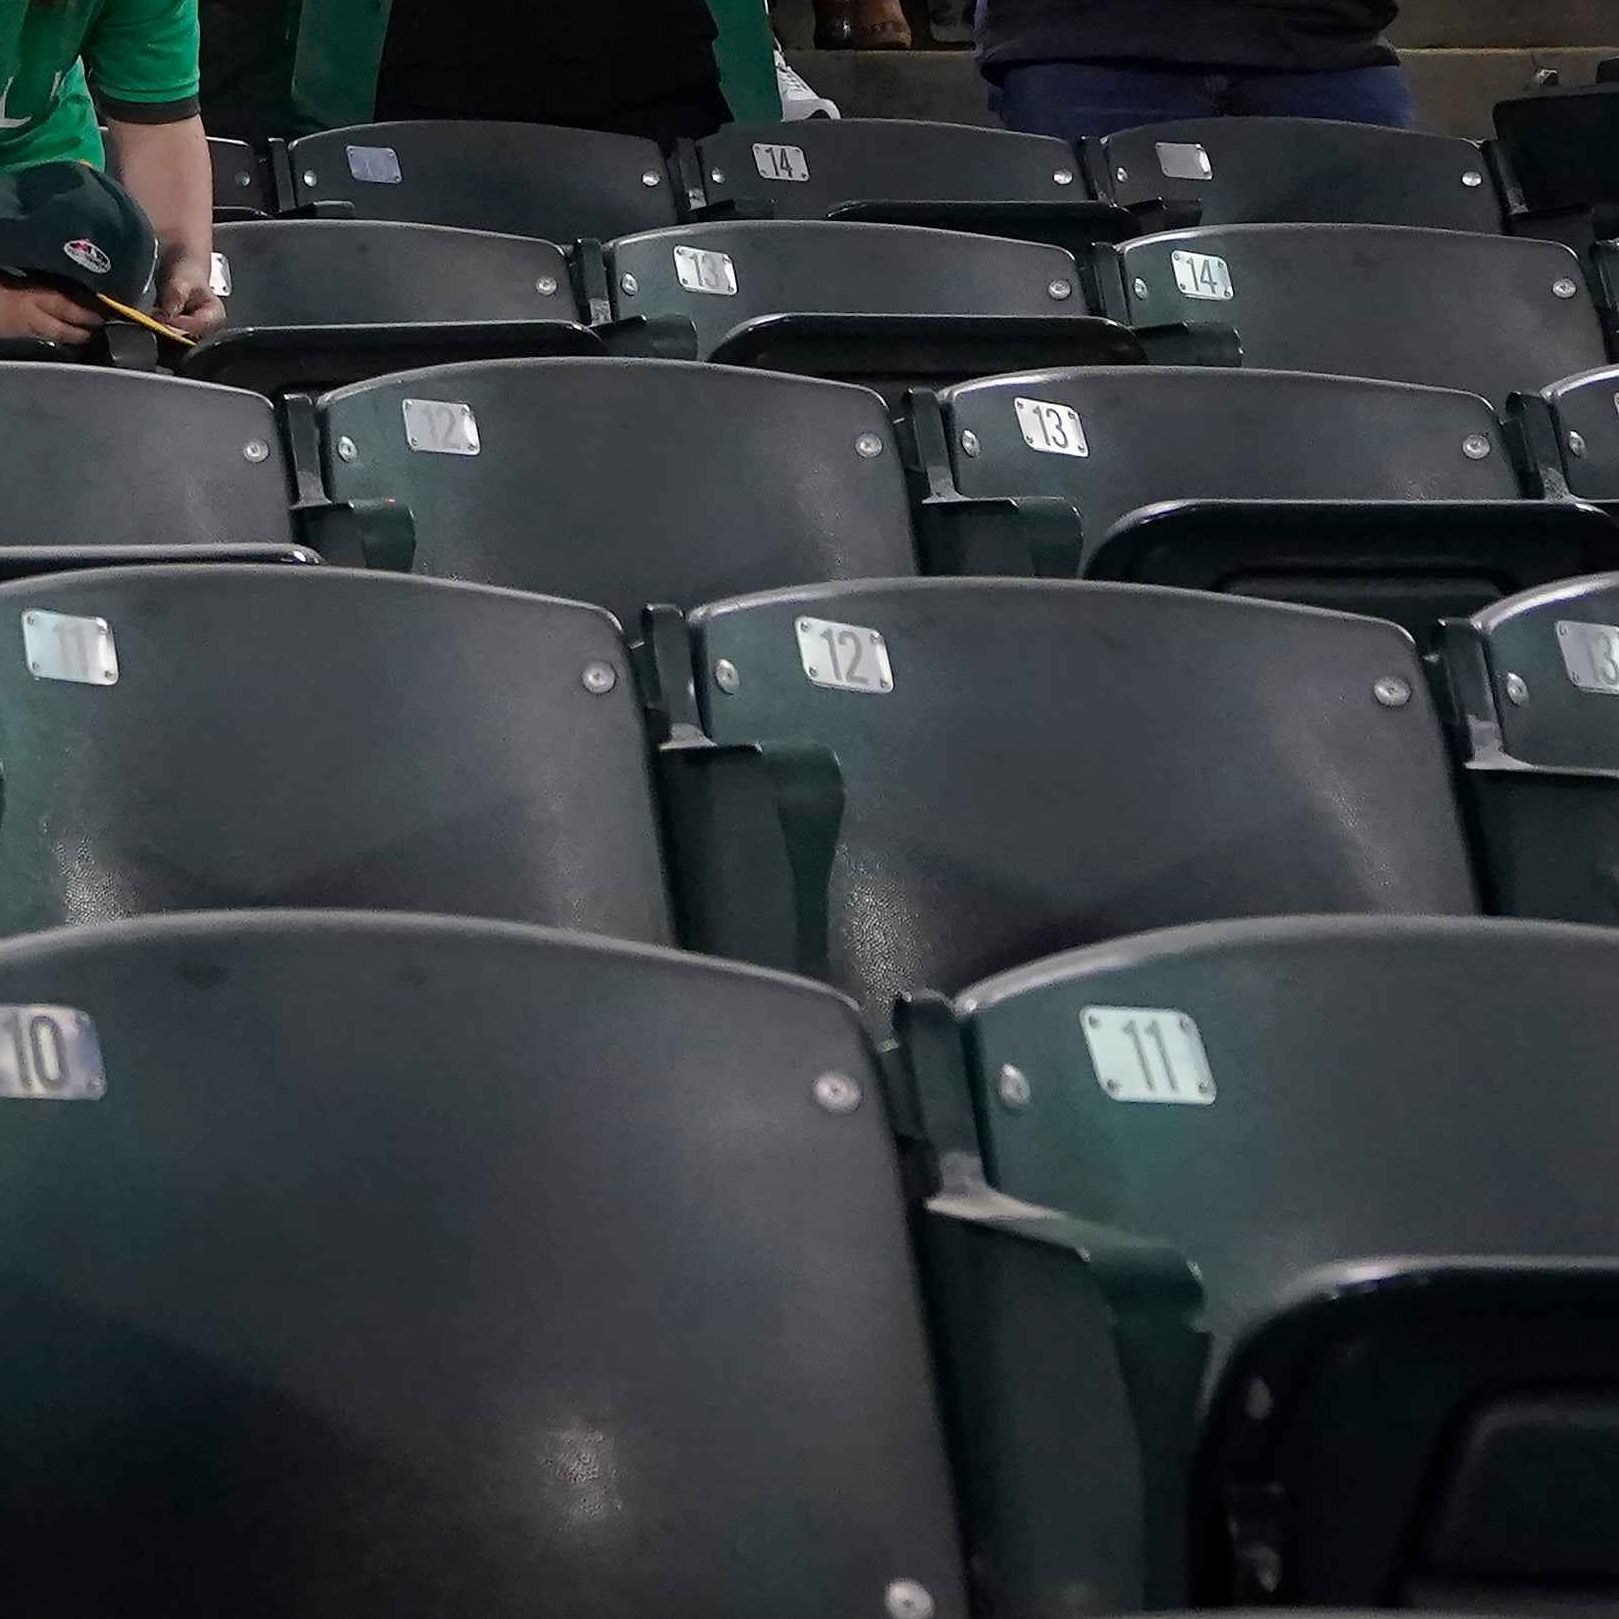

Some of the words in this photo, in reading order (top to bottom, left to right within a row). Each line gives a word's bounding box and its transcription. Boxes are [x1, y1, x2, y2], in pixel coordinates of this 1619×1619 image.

[764, 146, 793, 178] 14
[1186, 252, 1219, 295] 14
[1029, 405, 1070, 448] 13
[820, 628, 870, 684] 12
[3, 1016, 66, 1090] 10
[1122, 1018, 1180, 1093] 11
